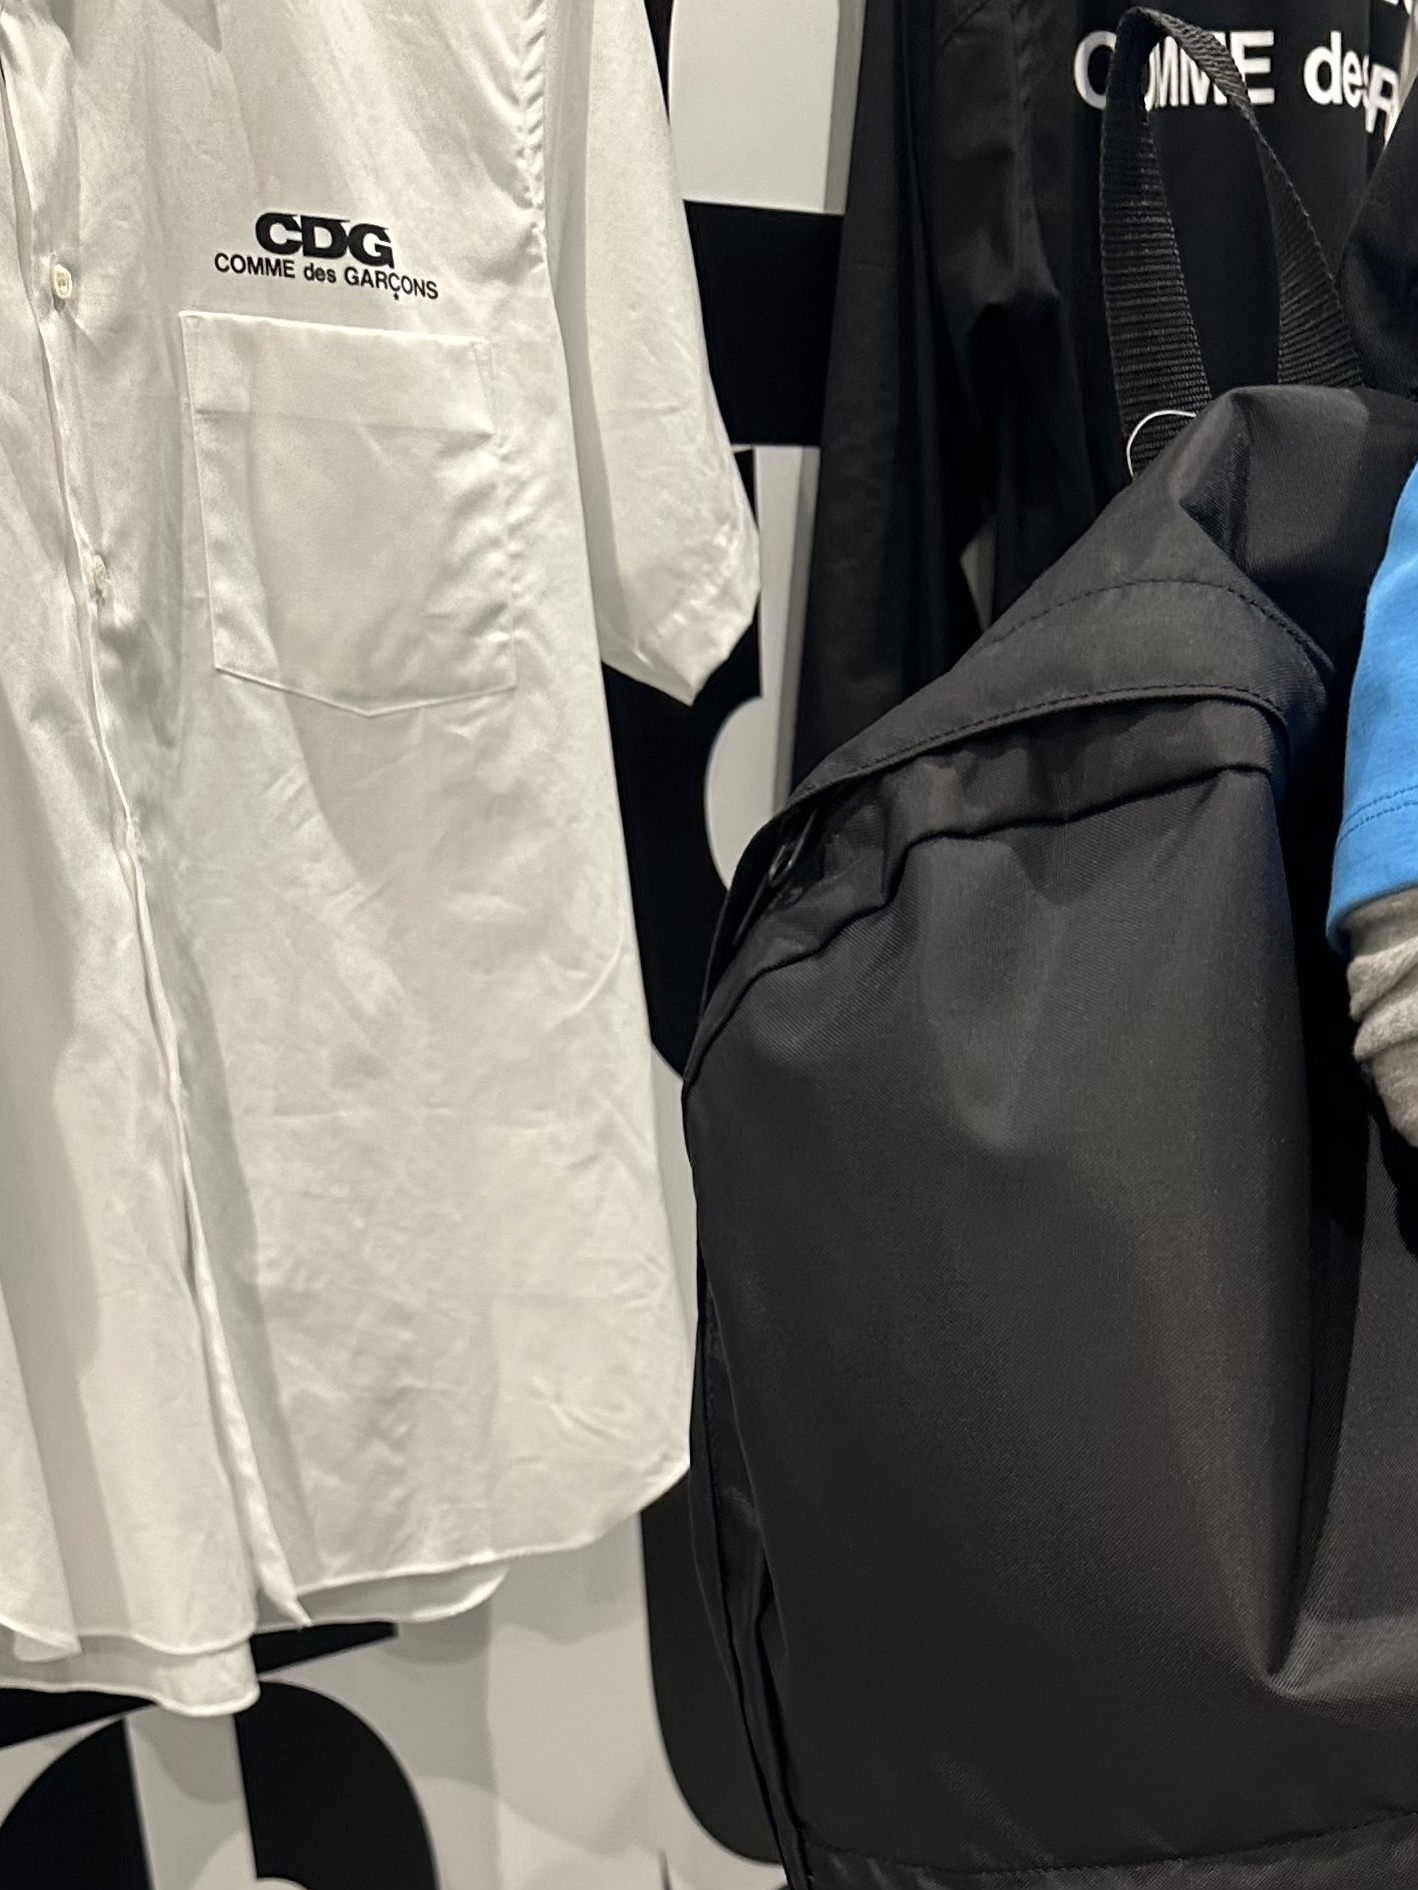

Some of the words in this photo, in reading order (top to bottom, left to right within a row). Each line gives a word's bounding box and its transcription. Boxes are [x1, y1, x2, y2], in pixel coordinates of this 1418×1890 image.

[255, 212, 395, 269] CDG
[214, 253, 296, 278] COMME
[304, 262, 337, 284] des
[344, 267, 439, 300] GARÇONS
